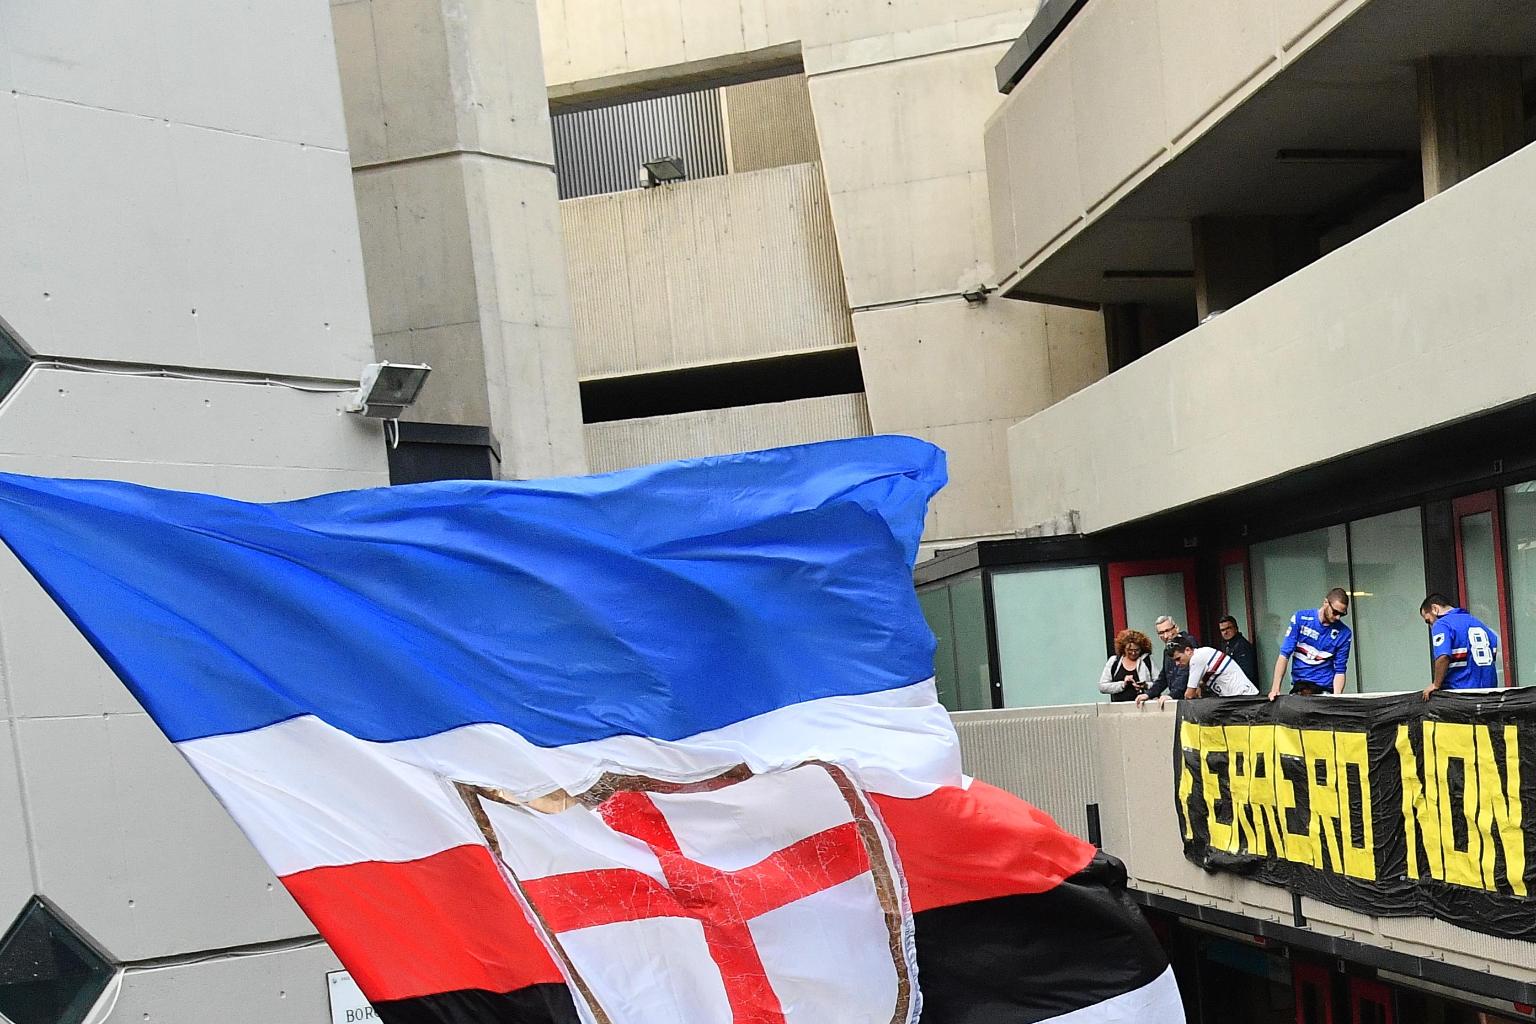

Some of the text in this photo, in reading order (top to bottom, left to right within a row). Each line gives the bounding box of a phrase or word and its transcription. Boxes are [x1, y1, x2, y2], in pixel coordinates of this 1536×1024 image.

[1467, 627, 1493, 667] 8
[1181, 724, 1374, 879] FERRERO
[1398, 723, 1524, 894] NON
